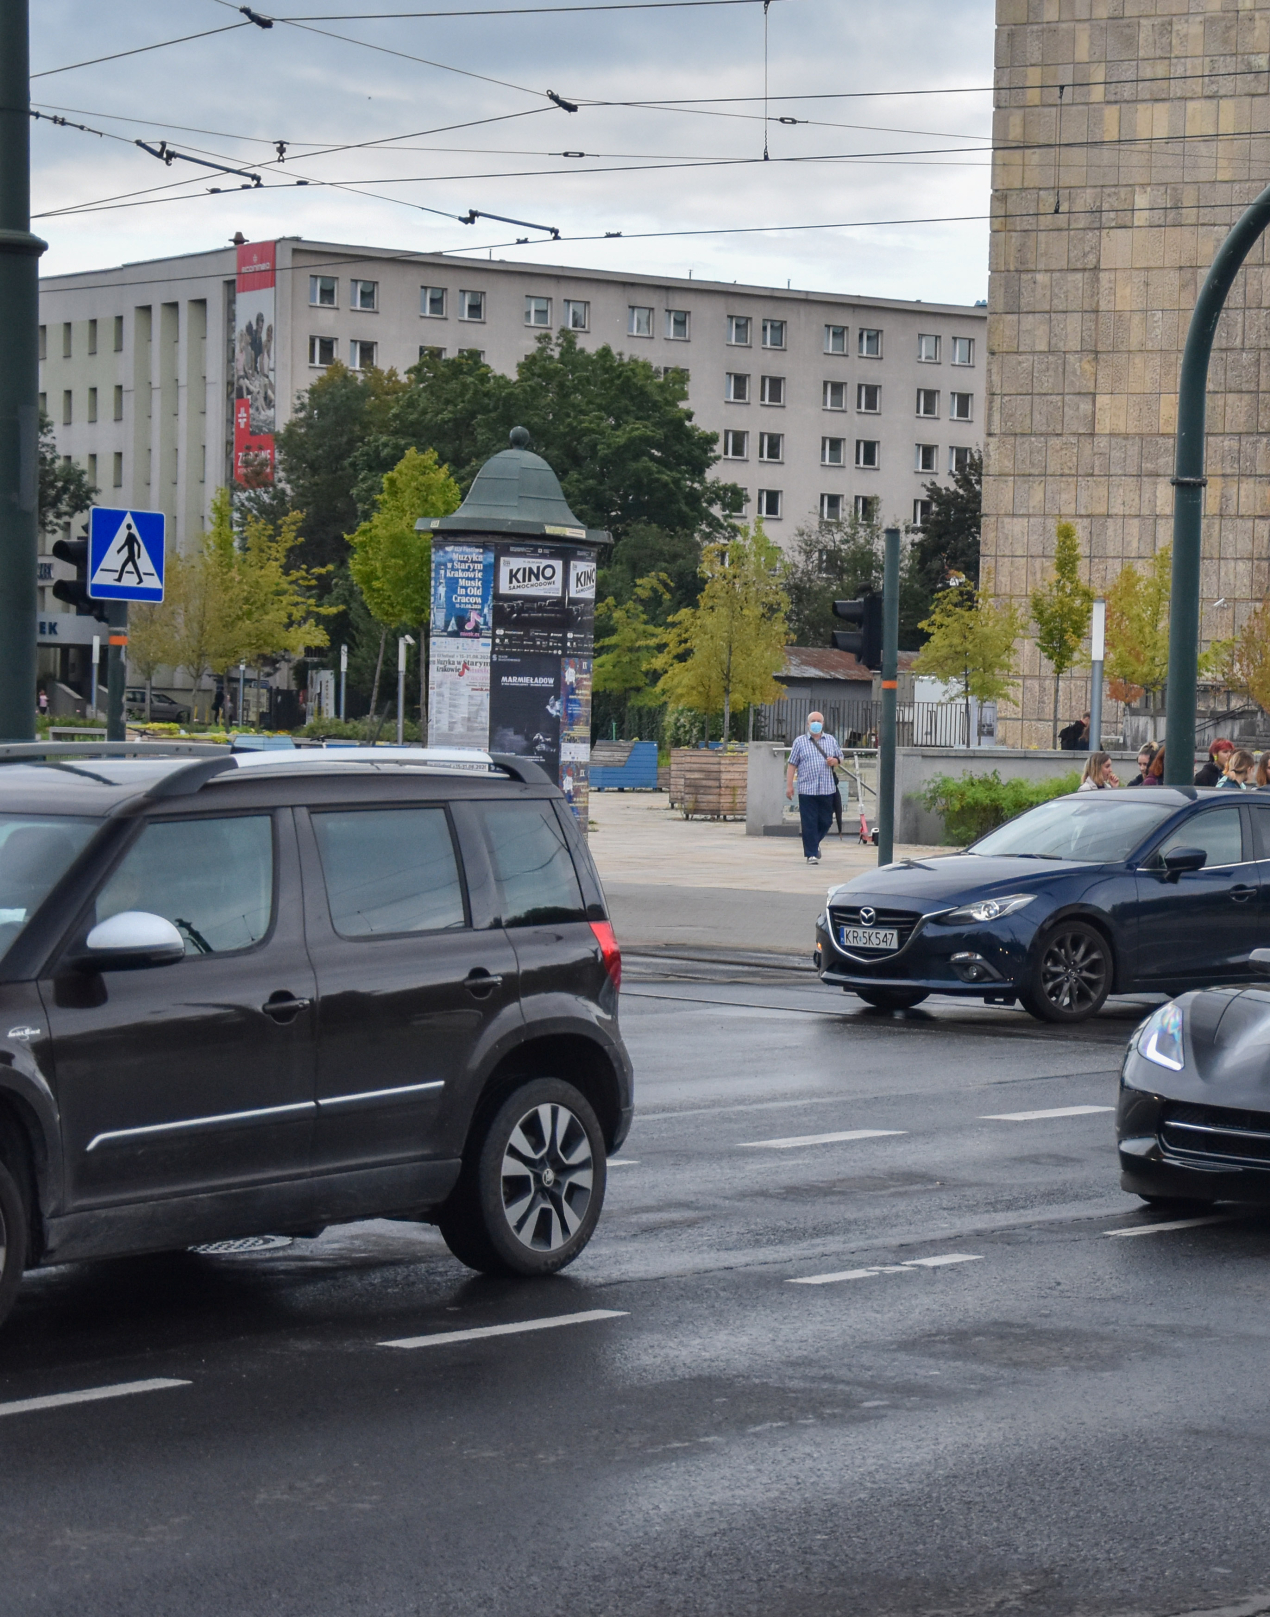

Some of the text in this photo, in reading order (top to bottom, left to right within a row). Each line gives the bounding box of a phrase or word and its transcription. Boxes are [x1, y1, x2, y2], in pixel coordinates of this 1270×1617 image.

[452, 553, 483, 562] Muzyka
[453, 562, 483, 571] Starym
[509, 564, 556, 584] KINO
[508, 581, 556, 590] SAMOCHODOWE
[457, 587, 482, 595] in Old
[845, 930, 859, 944] KR
[862, 931, 895, 946] 5K547
